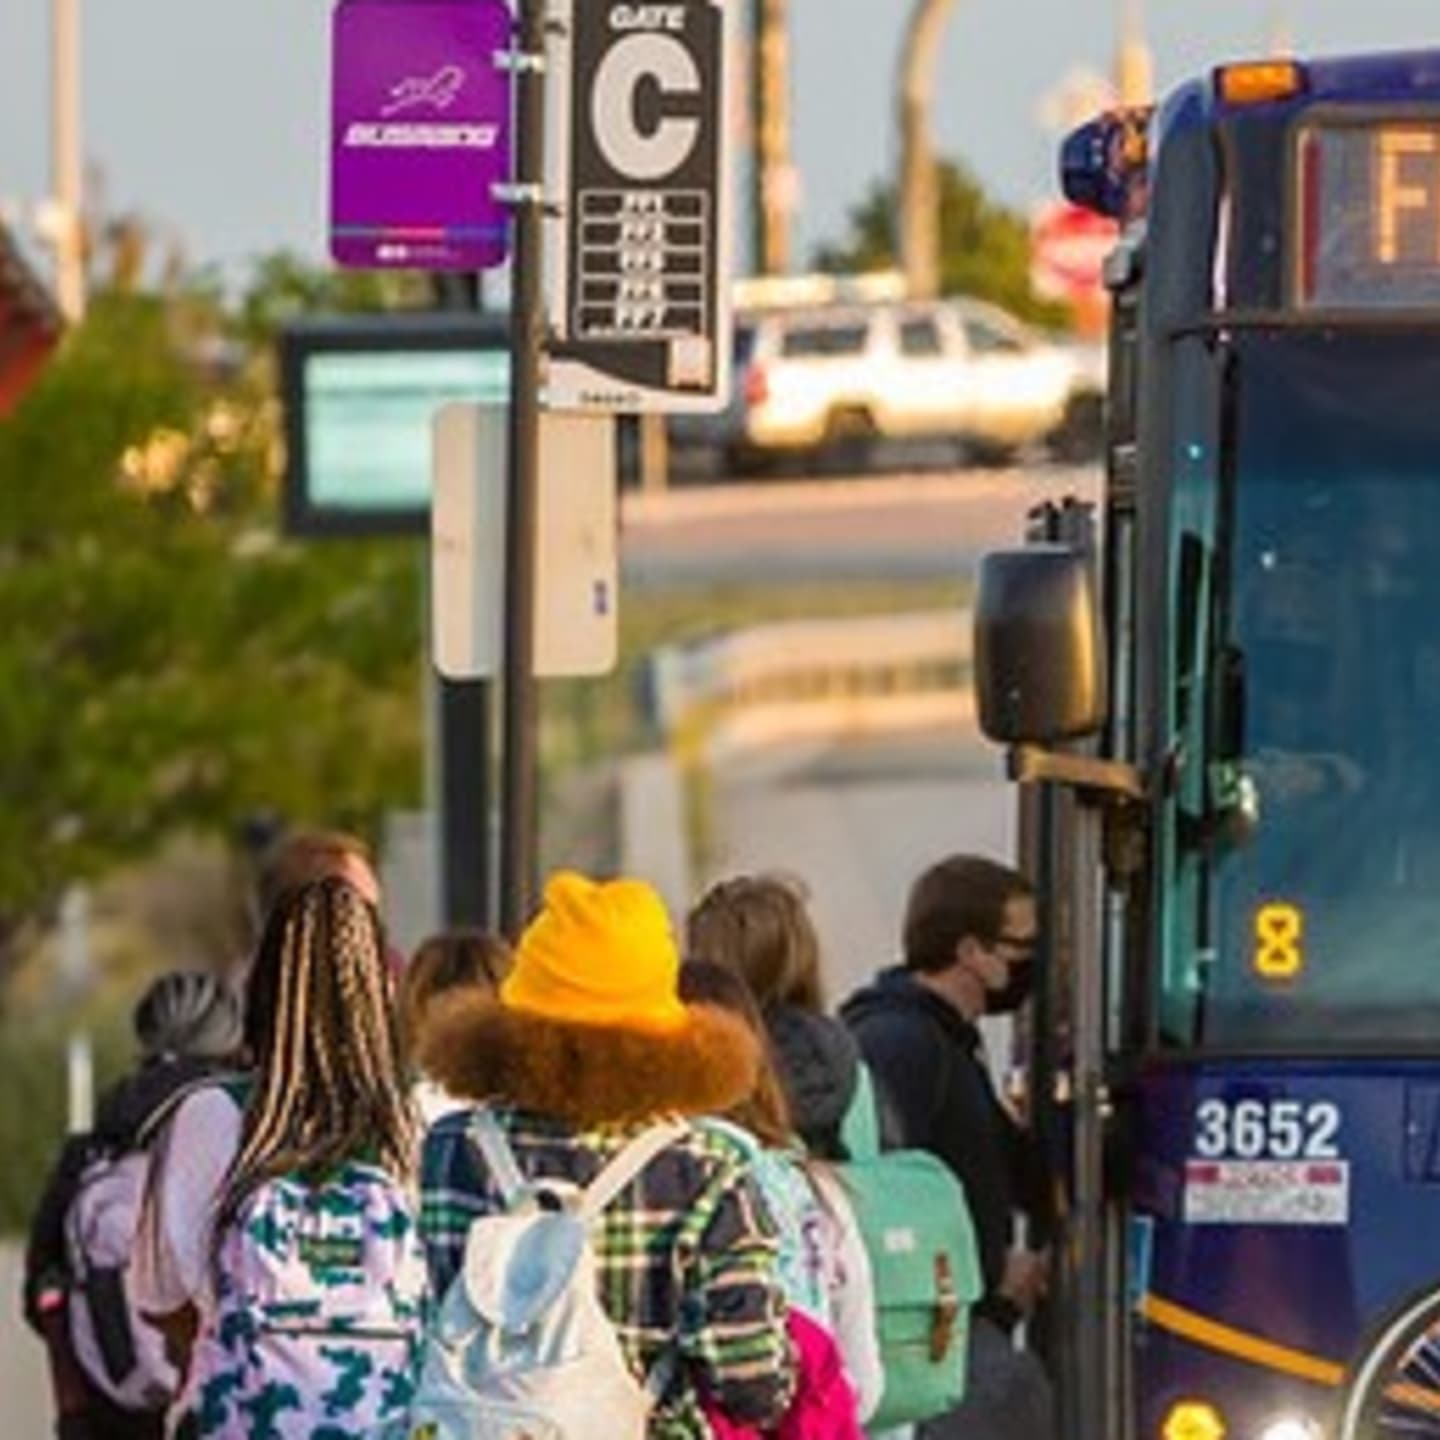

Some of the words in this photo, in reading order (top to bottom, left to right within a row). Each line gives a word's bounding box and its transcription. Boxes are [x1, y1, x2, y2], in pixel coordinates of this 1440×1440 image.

[609, 5, 685, 29] GATE
[591, 31, 701, 181] C
[1195, 1098, 1340, 1158] 3652
